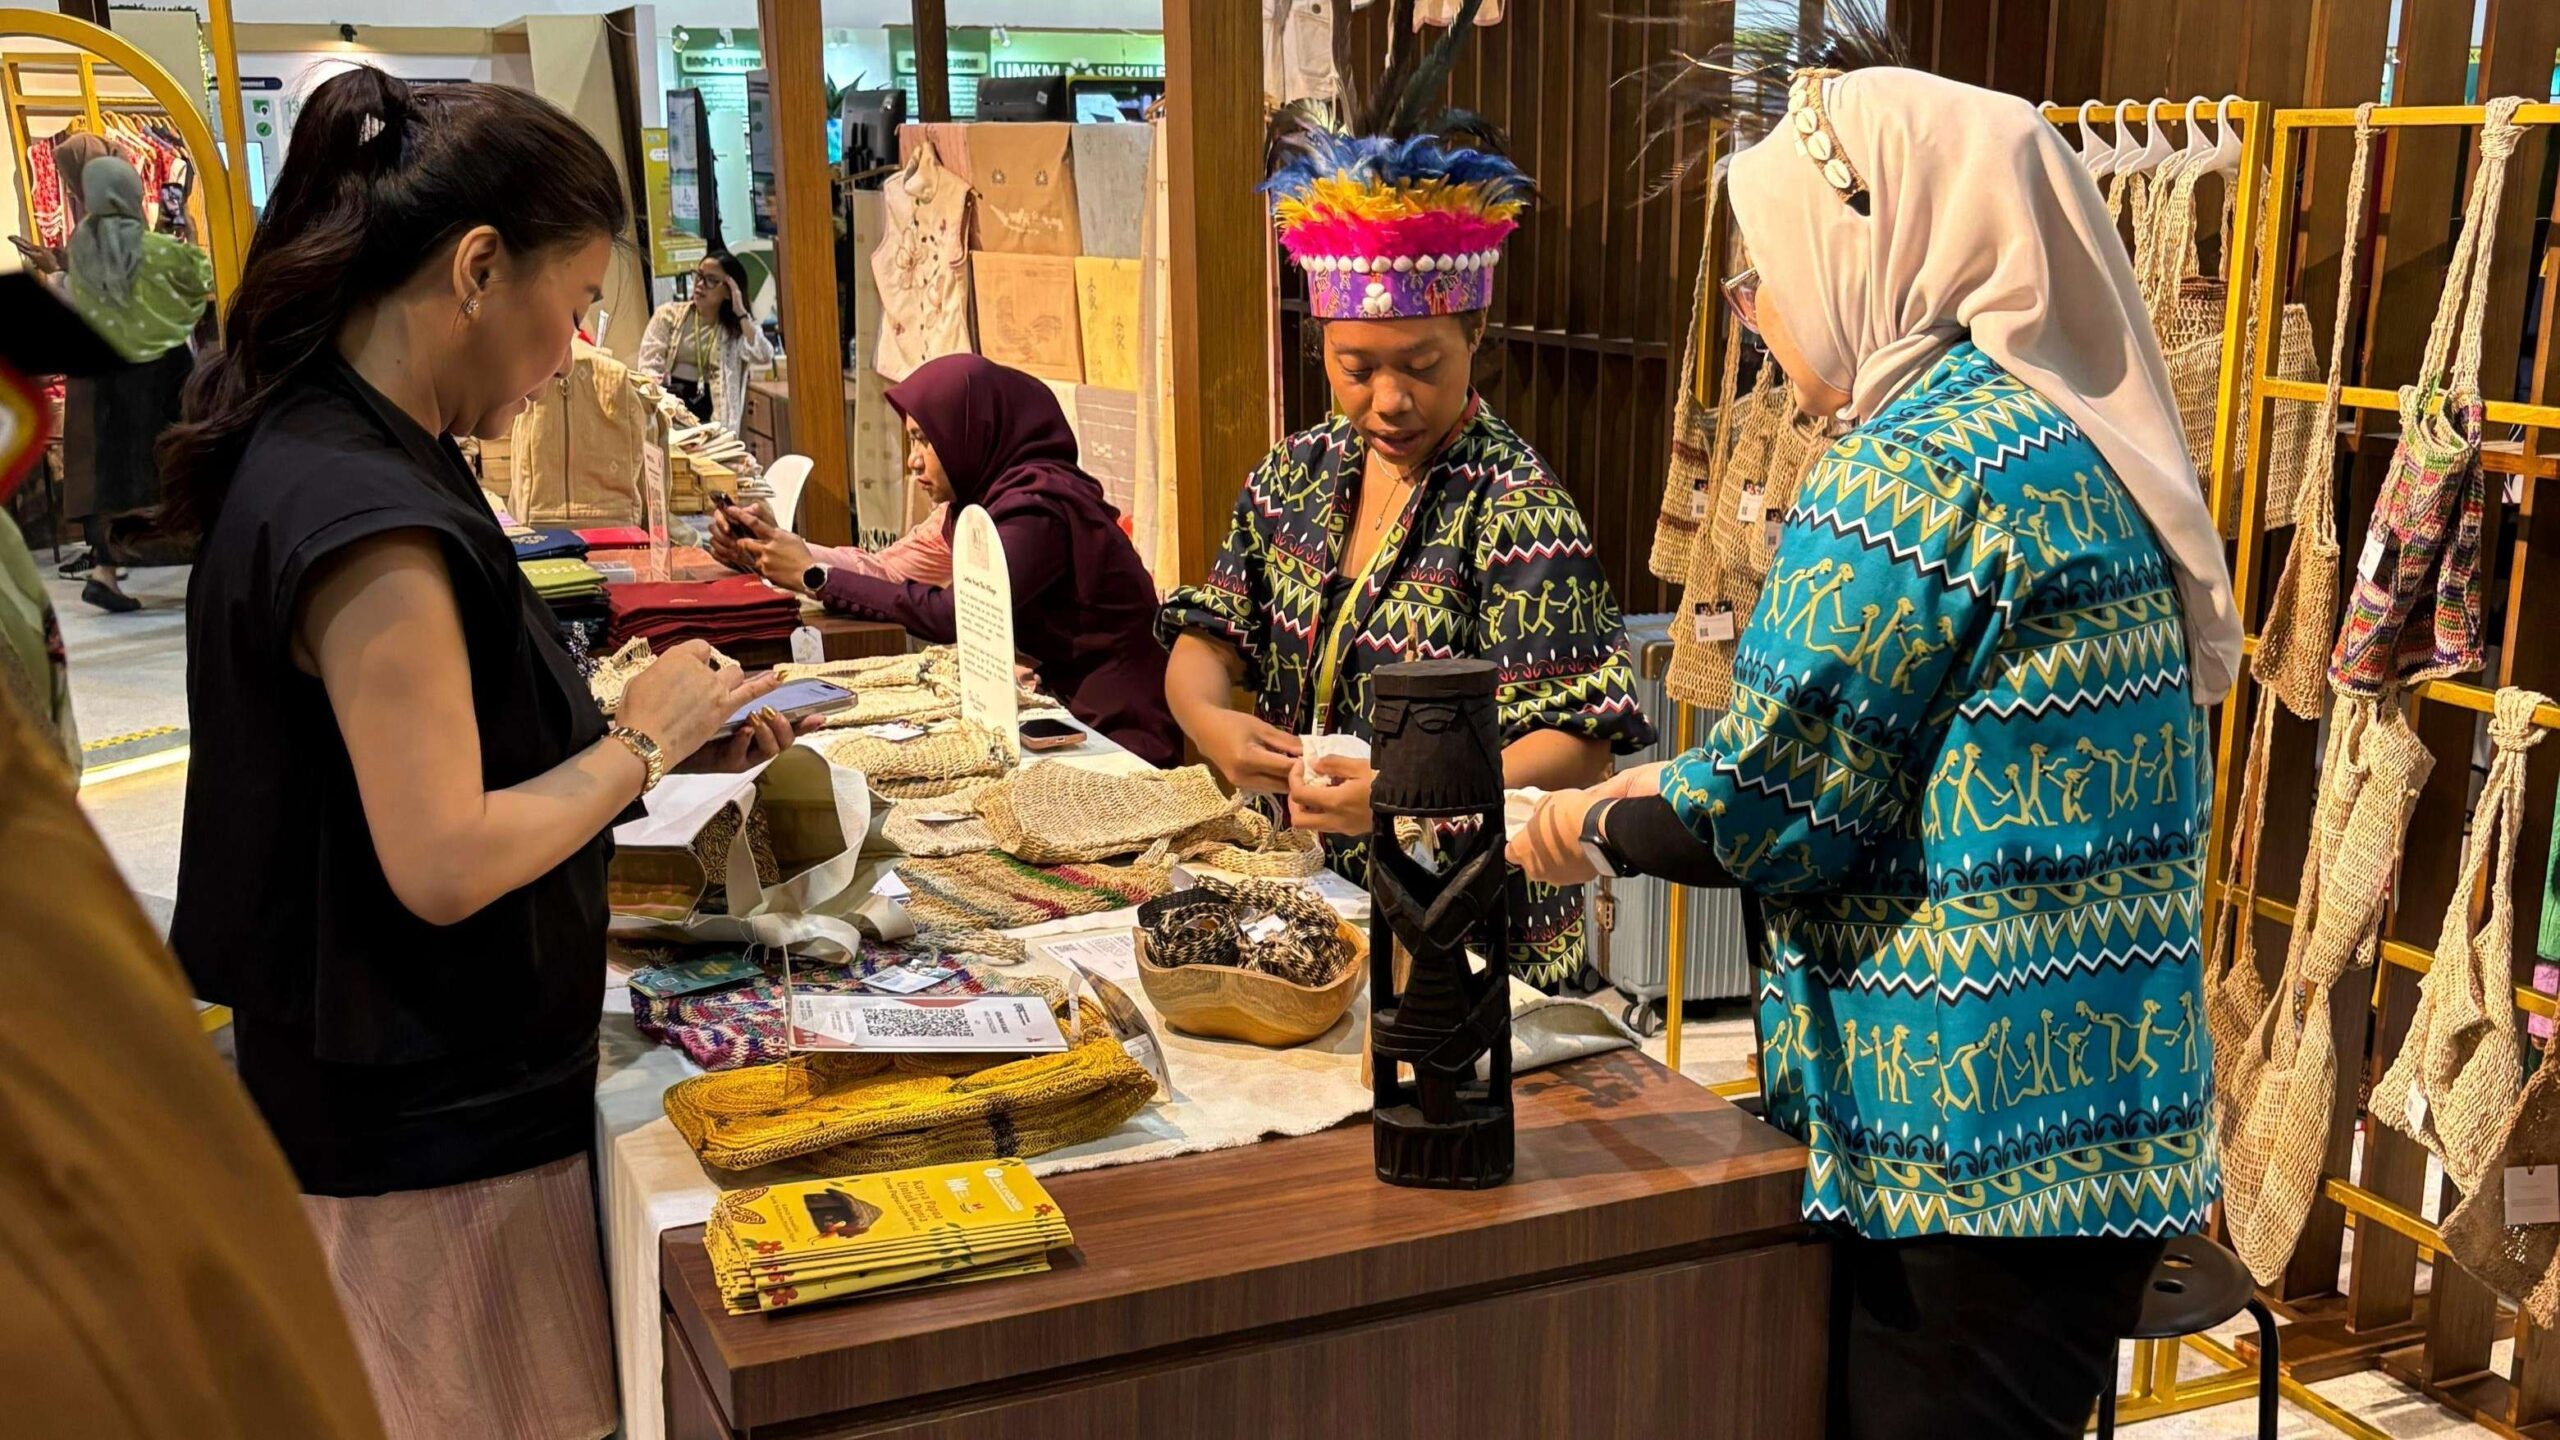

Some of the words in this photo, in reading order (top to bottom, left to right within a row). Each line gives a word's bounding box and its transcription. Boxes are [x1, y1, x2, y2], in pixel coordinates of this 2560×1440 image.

[897, 1181, 918, 1202] Untuk
[910, 1203, 928, 1221] Dunia
[912, 1180, 929, 1199] Karya
[924, 1200, 943, 1219] Papua
